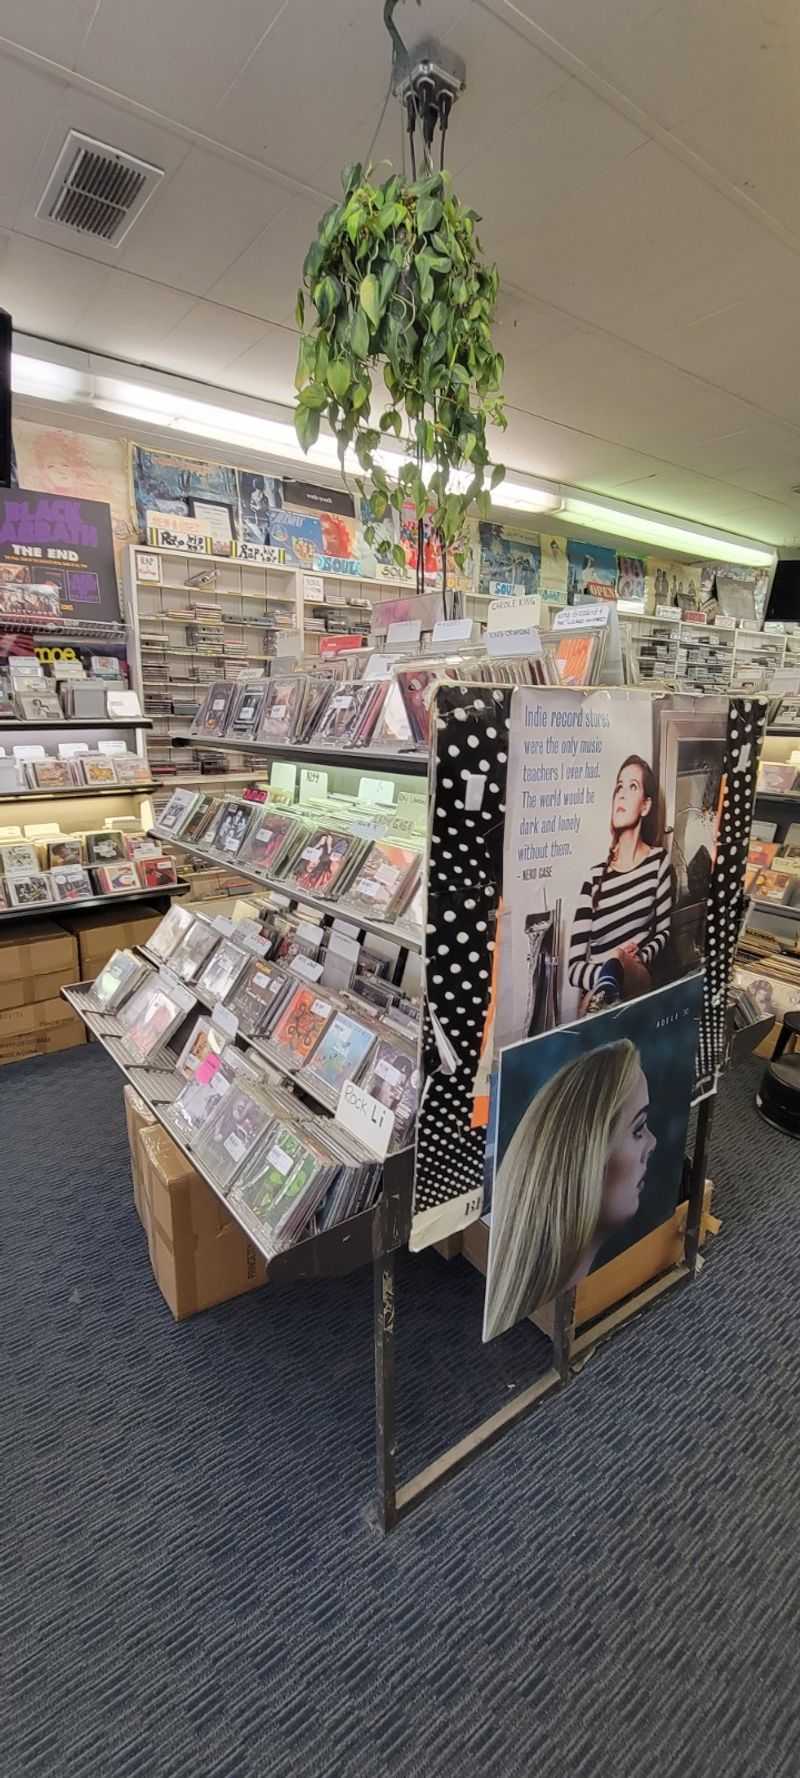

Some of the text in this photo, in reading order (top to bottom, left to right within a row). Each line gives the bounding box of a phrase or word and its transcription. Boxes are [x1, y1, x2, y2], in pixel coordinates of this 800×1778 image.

[0, 519, 97, 546] ABBATH
[11, 544, 43, 558] THE
[46, 547, 80, 563] END
[525, 704, 548, 729] Indie
[550, 707, 583, 728] record
[524, 736, 603, 758] were the only music
[523, 764, 559, 783] teachers
[566, 766, 583, 780] ever
[585, 761, 601, 779] had.
[522, 786, 595, 808] The world would be
[520, 813, 581, 836] dark and lonely
[518, 840, 573, 861] without them.
[539, 866, 553, 879] CASE
